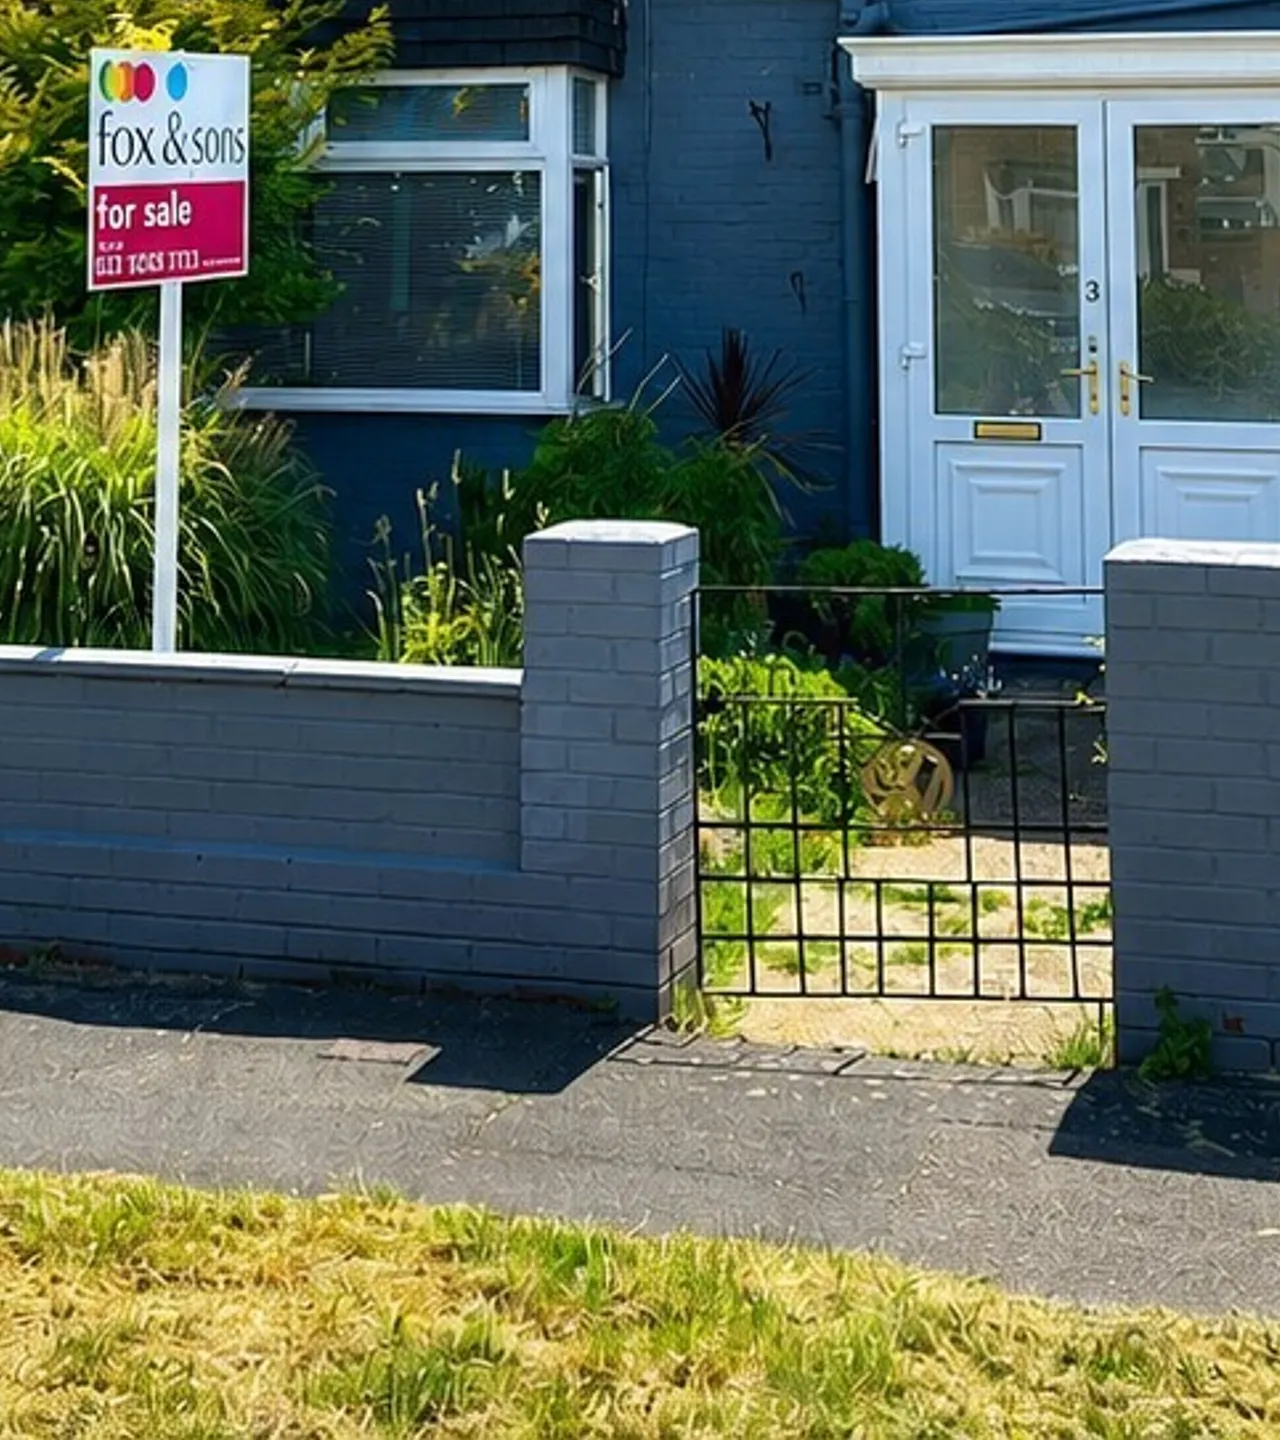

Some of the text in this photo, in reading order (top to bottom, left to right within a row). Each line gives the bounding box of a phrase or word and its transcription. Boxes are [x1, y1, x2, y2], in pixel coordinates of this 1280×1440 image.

[98, 110, 246, 166] fox & sons
[96, 191, 191, 229] for sale
[1085, 279, 1100, 303] 3
